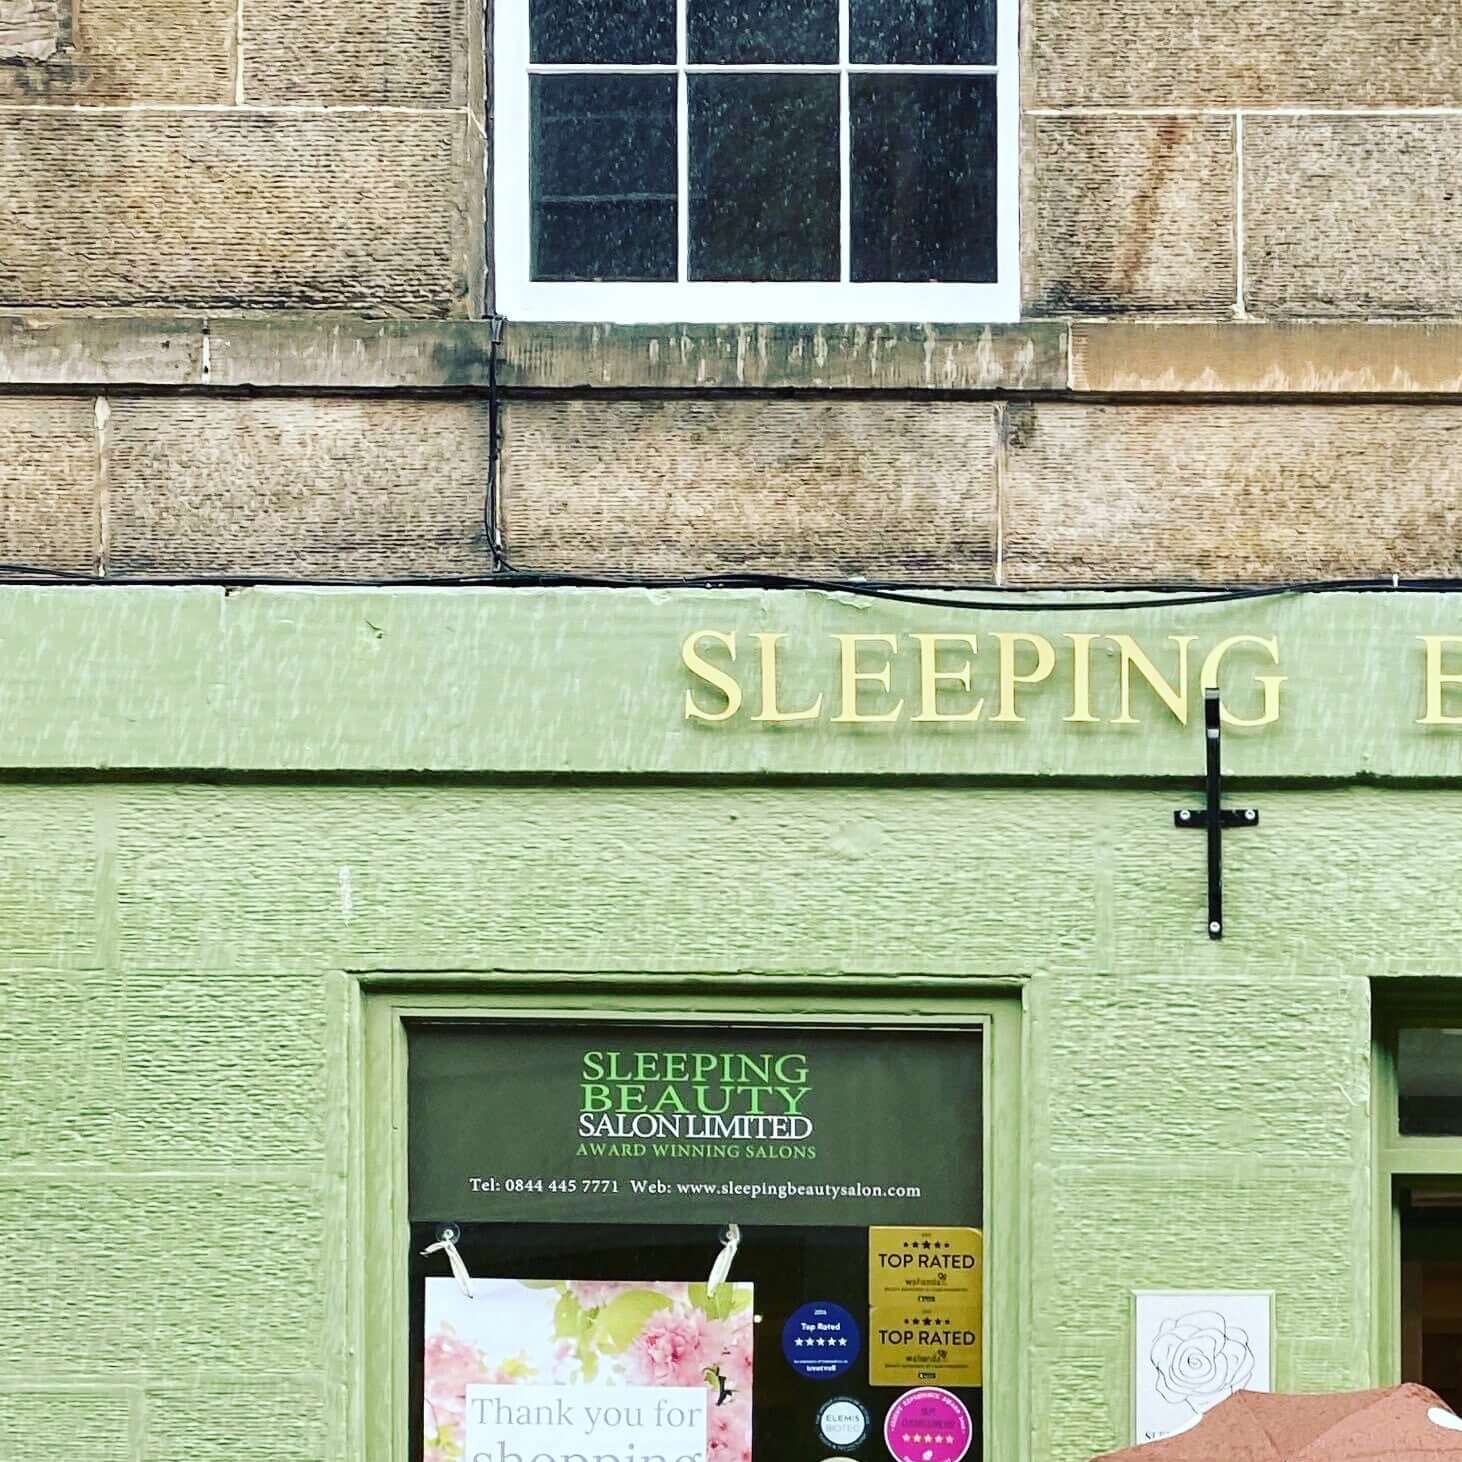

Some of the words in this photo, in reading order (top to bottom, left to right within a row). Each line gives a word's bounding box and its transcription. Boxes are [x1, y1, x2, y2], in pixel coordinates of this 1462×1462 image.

[681, 630, 1288, 728] SLEEPING
[582, 1051, 809, 1084] SLEEPING
[580, 1083, 812, 1115] BEAUTY
[576, 1143, 646, 1157] AWARD
[653, 1144, 740, 1158] WINNING
[746, 1145, 816, 1159] SALONS
[469, 1177, 500, 1192] Tel:
[504, 1178, 543, 1192] 0844
[548, 1179, 577, 1193] 445
[582, 1179, 619, 1194] 7771
[630, 1179, 672, 1194] Web:
[676, 1180, 921, 1199] www.sleepingbeautysalon.com
[878, 1254, 914, 1268] TOP
[919, 1254, 975, 1269] RATED
[879, 1330, 914, 1345] TOP
[919, 1330, 976, 1345] RATED
[472, 1397, 574, 1425] Thank
[583, 1406, 644, 1434] you
[655, 1399, 702, 1428] for
